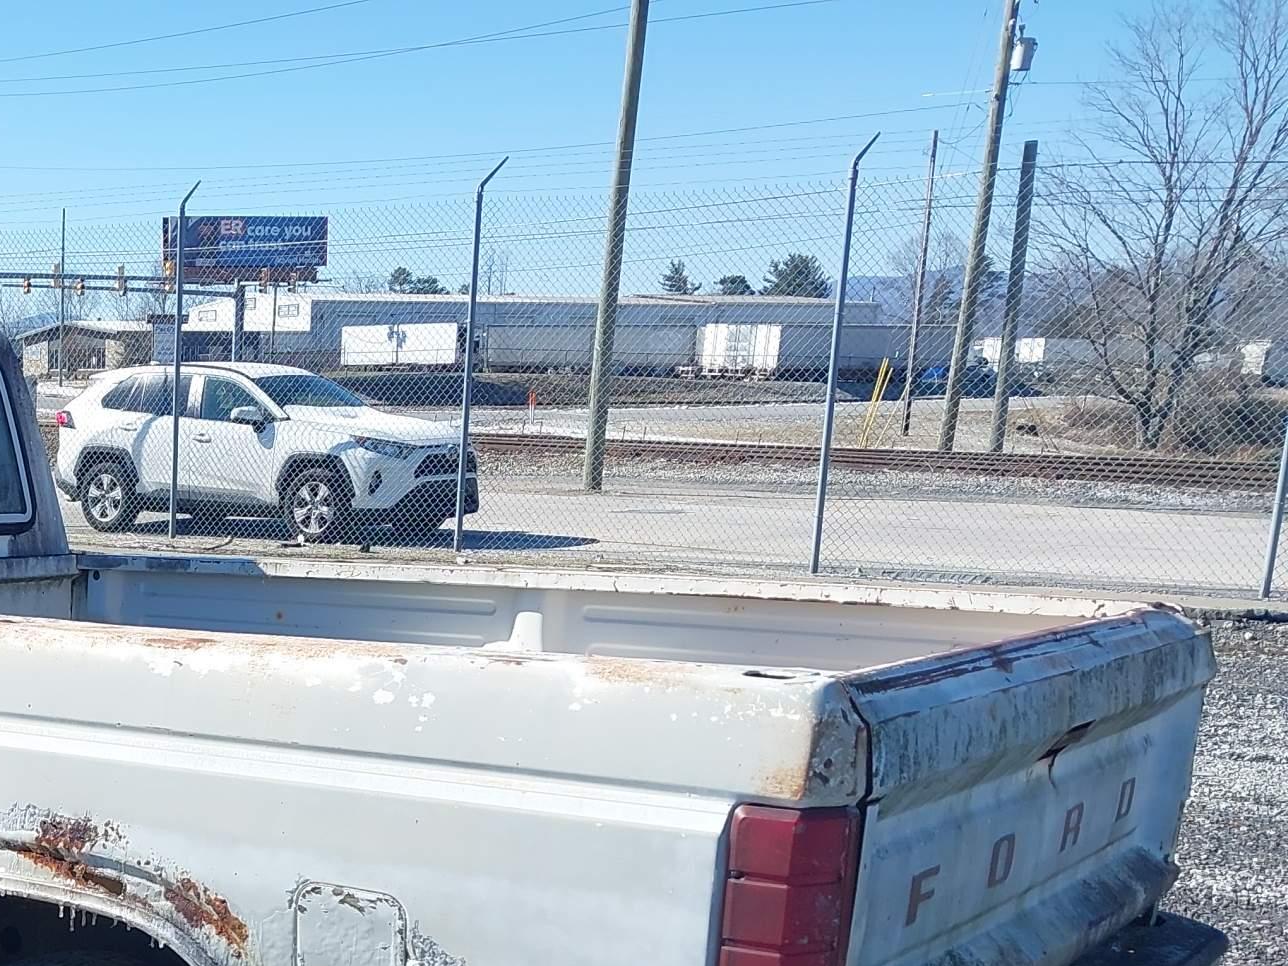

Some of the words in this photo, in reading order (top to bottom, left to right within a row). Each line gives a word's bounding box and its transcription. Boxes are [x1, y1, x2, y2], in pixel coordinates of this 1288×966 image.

[220, 219, 243, 235] ER
[247, 224, 280, 236] care
[285, 224, 312, 240] you
[904, 776, 1137, 928] FORD
